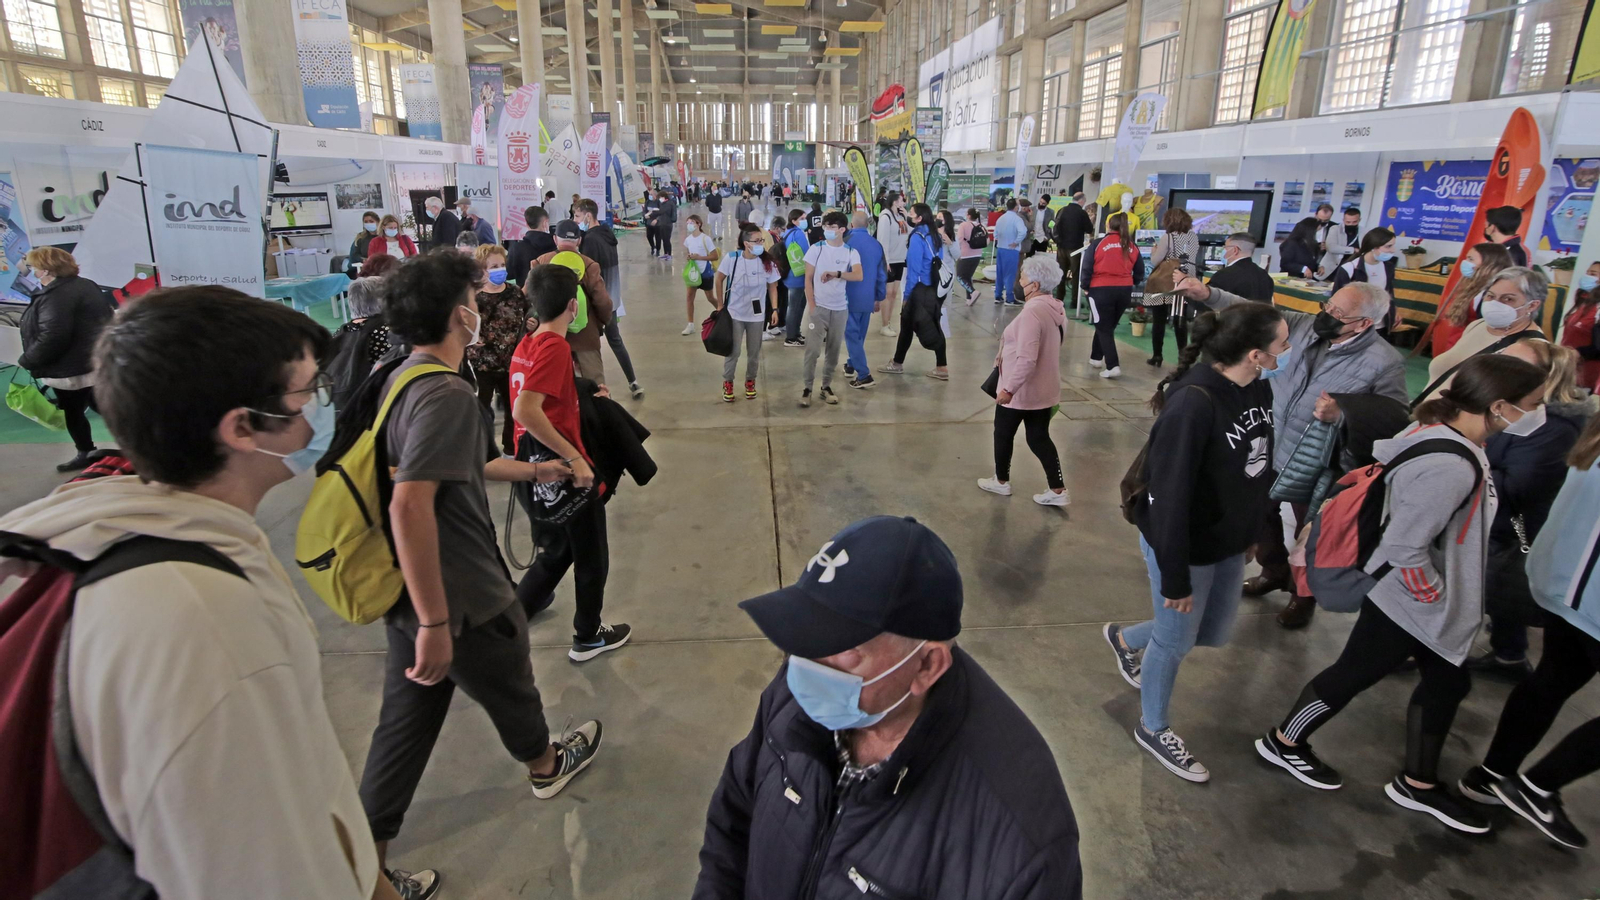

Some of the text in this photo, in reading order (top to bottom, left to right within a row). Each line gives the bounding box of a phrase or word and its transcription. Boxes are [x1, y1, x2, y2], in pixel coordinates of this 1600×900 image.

[297, 0, 341, 10] IFECA
[403, 70, 432, 78] IFECA
[945, 50, 990, 95] Diputación
[952, 97, 978, 127] Cádiz
[81, 117, 104, 132] CÁDIZ
[1344, 126, 1371, 138] BORNOS
[566, 160, 580, 175] ES
[1421, 174, 1487, 199] Borno
[164, 184, 246, 222] imd
[1422, 204, 1476, 214] Turismo Deport
[171, 274, 258, 284] Deporte y Salud
